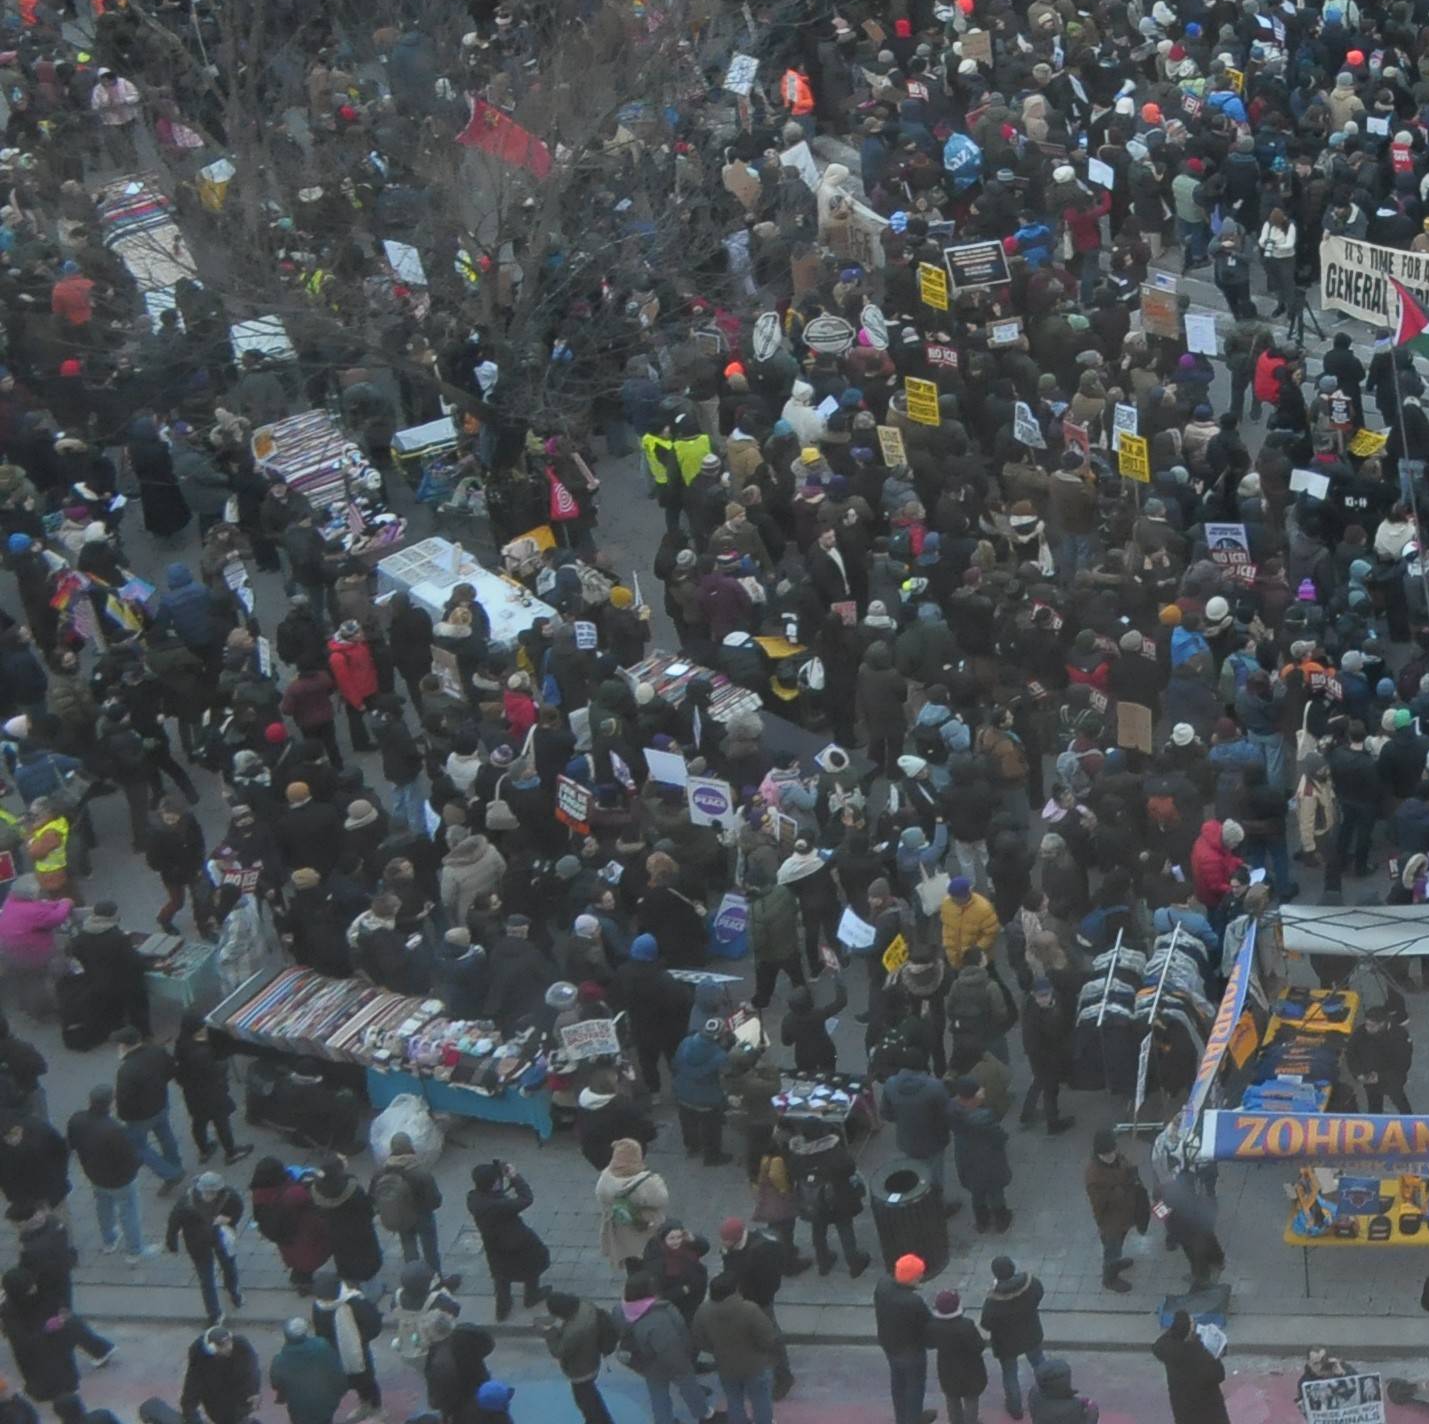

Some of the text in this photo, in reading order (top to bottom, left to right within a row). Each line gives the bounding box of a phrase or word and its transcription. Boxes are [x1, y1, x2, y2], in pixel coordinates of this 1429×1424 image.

[1345, 241, 1363, 264] IT'S
[1370, 247, 1394, 274] TIME
[1402, 255, 1421, 280] FOR
[1326, 262, 1389, 316] GENERAL
[1212, 552, 1247, 563] NO ICE!
